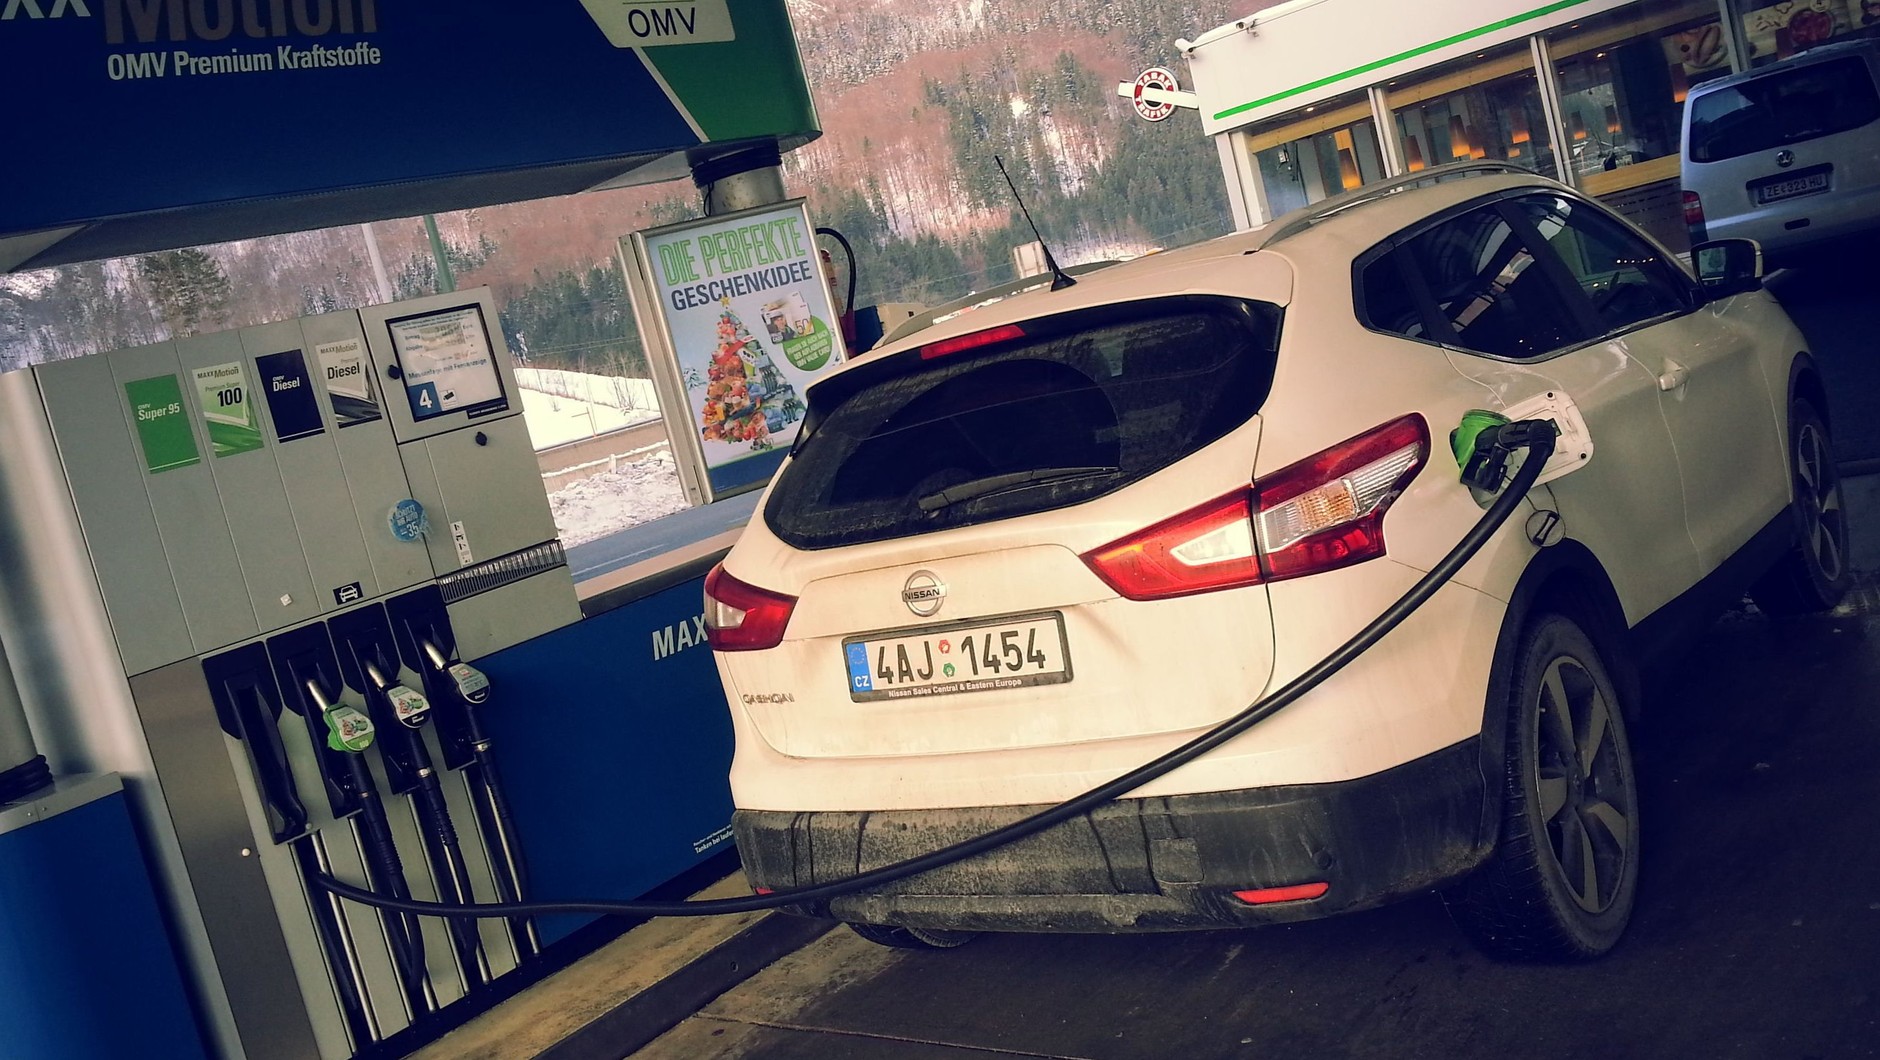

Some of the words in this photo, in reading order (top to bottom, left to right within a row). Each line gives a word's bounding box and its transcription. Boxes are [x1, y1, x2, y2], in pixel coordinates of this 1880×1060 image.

[628, 7, 695, 38] OMV
[107, 52, 167, 80] OMV
[174, 48, 273, 76] Premium
[277, 42, 381, 70] Kraftstoffe
[1766, 186, 1780, 197] ZE
[658, 239, 700, 287] DIE
[698, 216, 806, 278] PERFEKTE
[671, 260, 812, 311] GESCHENKIDEE
[327, 362, 360, 379] Diesel
[273, 377, 300, 392] Diesel
[217, 387, 242, 407] 100
[420, 389, 433, 408] 4
[138, 407, 167, 421] Super
[168, 402, 180, 414] 95
[905, 588, 940, 600] NISSAN
[877, 640, 934, 684] 4AJ
[961, 628, 1046, 676] 1454
[855, 675, 869, 688] CZ
[888, 690, 912, 698] Nissan
[913, 688, 932, 696] Sales
[932, 685, 958, 694] Central
[959, 683, 965, 691] &
[966, 681, 994, 690] Eastern
